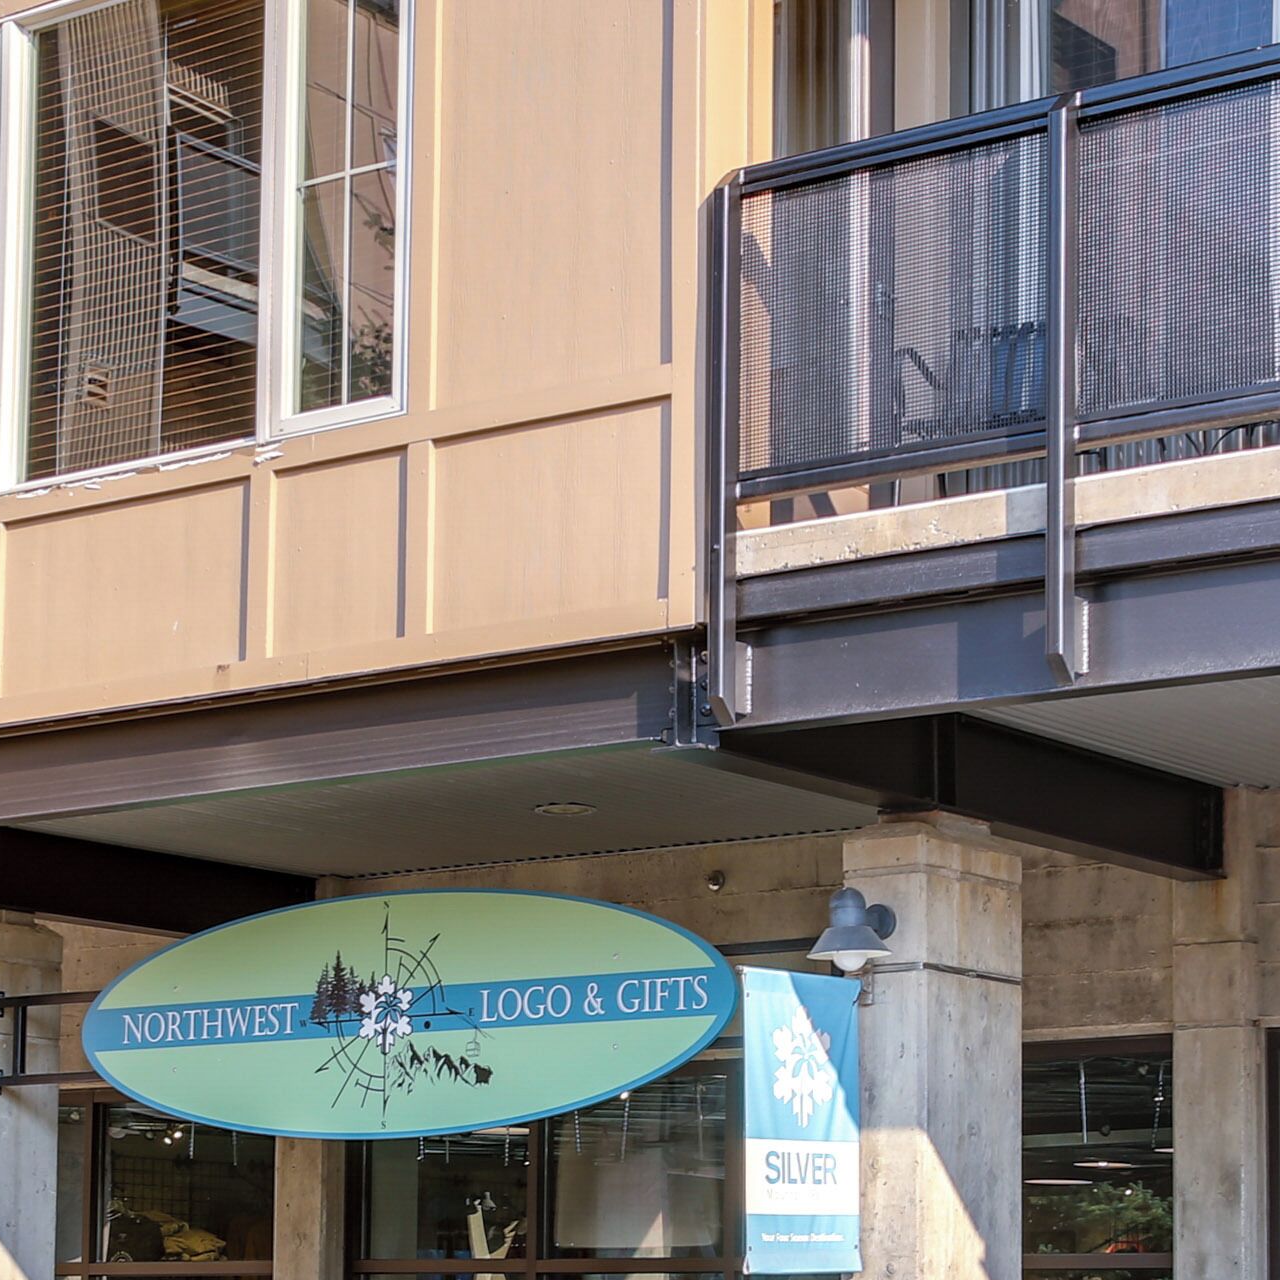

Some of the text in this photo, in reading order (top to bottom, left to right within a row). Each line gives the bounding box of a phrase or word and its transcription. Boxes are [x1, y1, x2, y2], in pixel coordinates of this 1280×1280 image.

[479, 975, 710, 1022] LOGO & GIFTS
[122, 1002, 300, 1045] NORTHWEST
[764, 1150, 838, 1185] SILVER
[761, 1232, 775, 1242] Your
